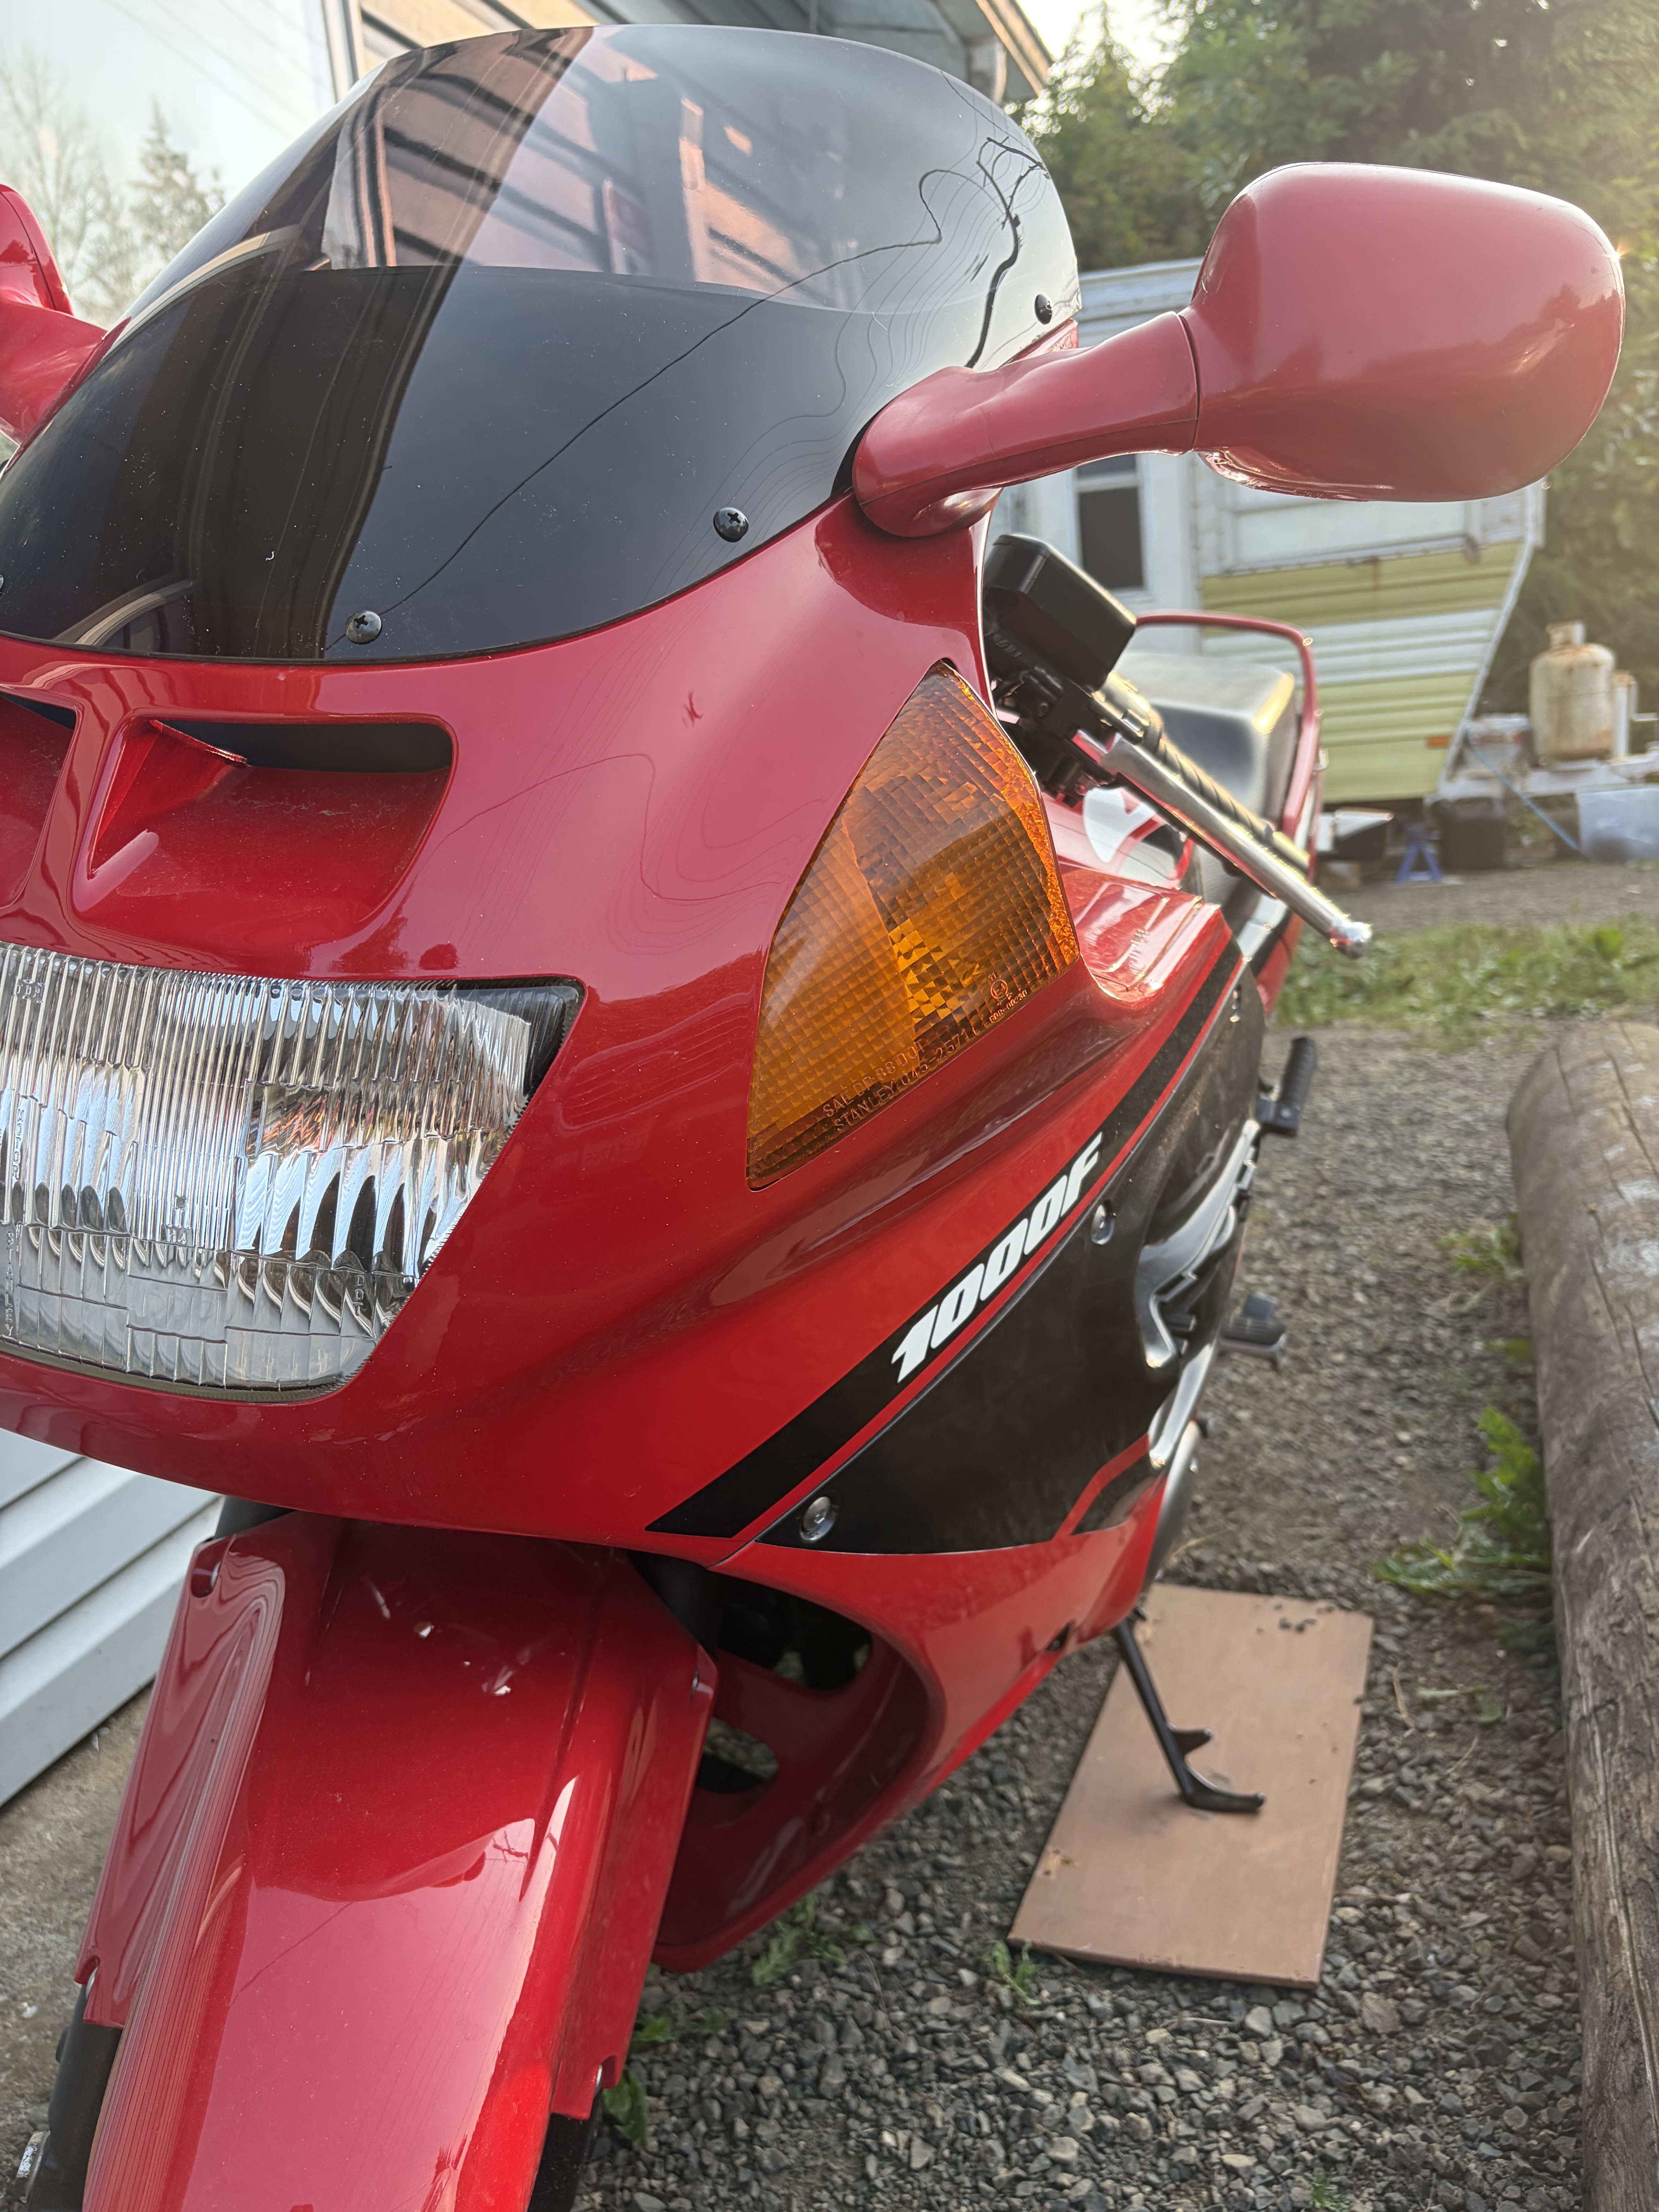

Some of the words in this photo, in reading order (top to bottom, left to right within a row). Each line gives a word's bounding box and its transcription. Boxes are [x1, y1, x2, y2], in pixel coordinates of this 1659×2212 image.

[823, 1090, 854, 1118] SAE
[896, 1039, 926, 1066] DOT
[833, 1081, 896, 1132] STANLEY
[12, 1108, 24, 1180] MOTOR
[167, 1228, 187, 1244] H4
[891, 1132, 1103, 1383] 1000F
[5, 1230, 14, 1336] STANLEY
[353, 1274, 365, 1316] DOT
